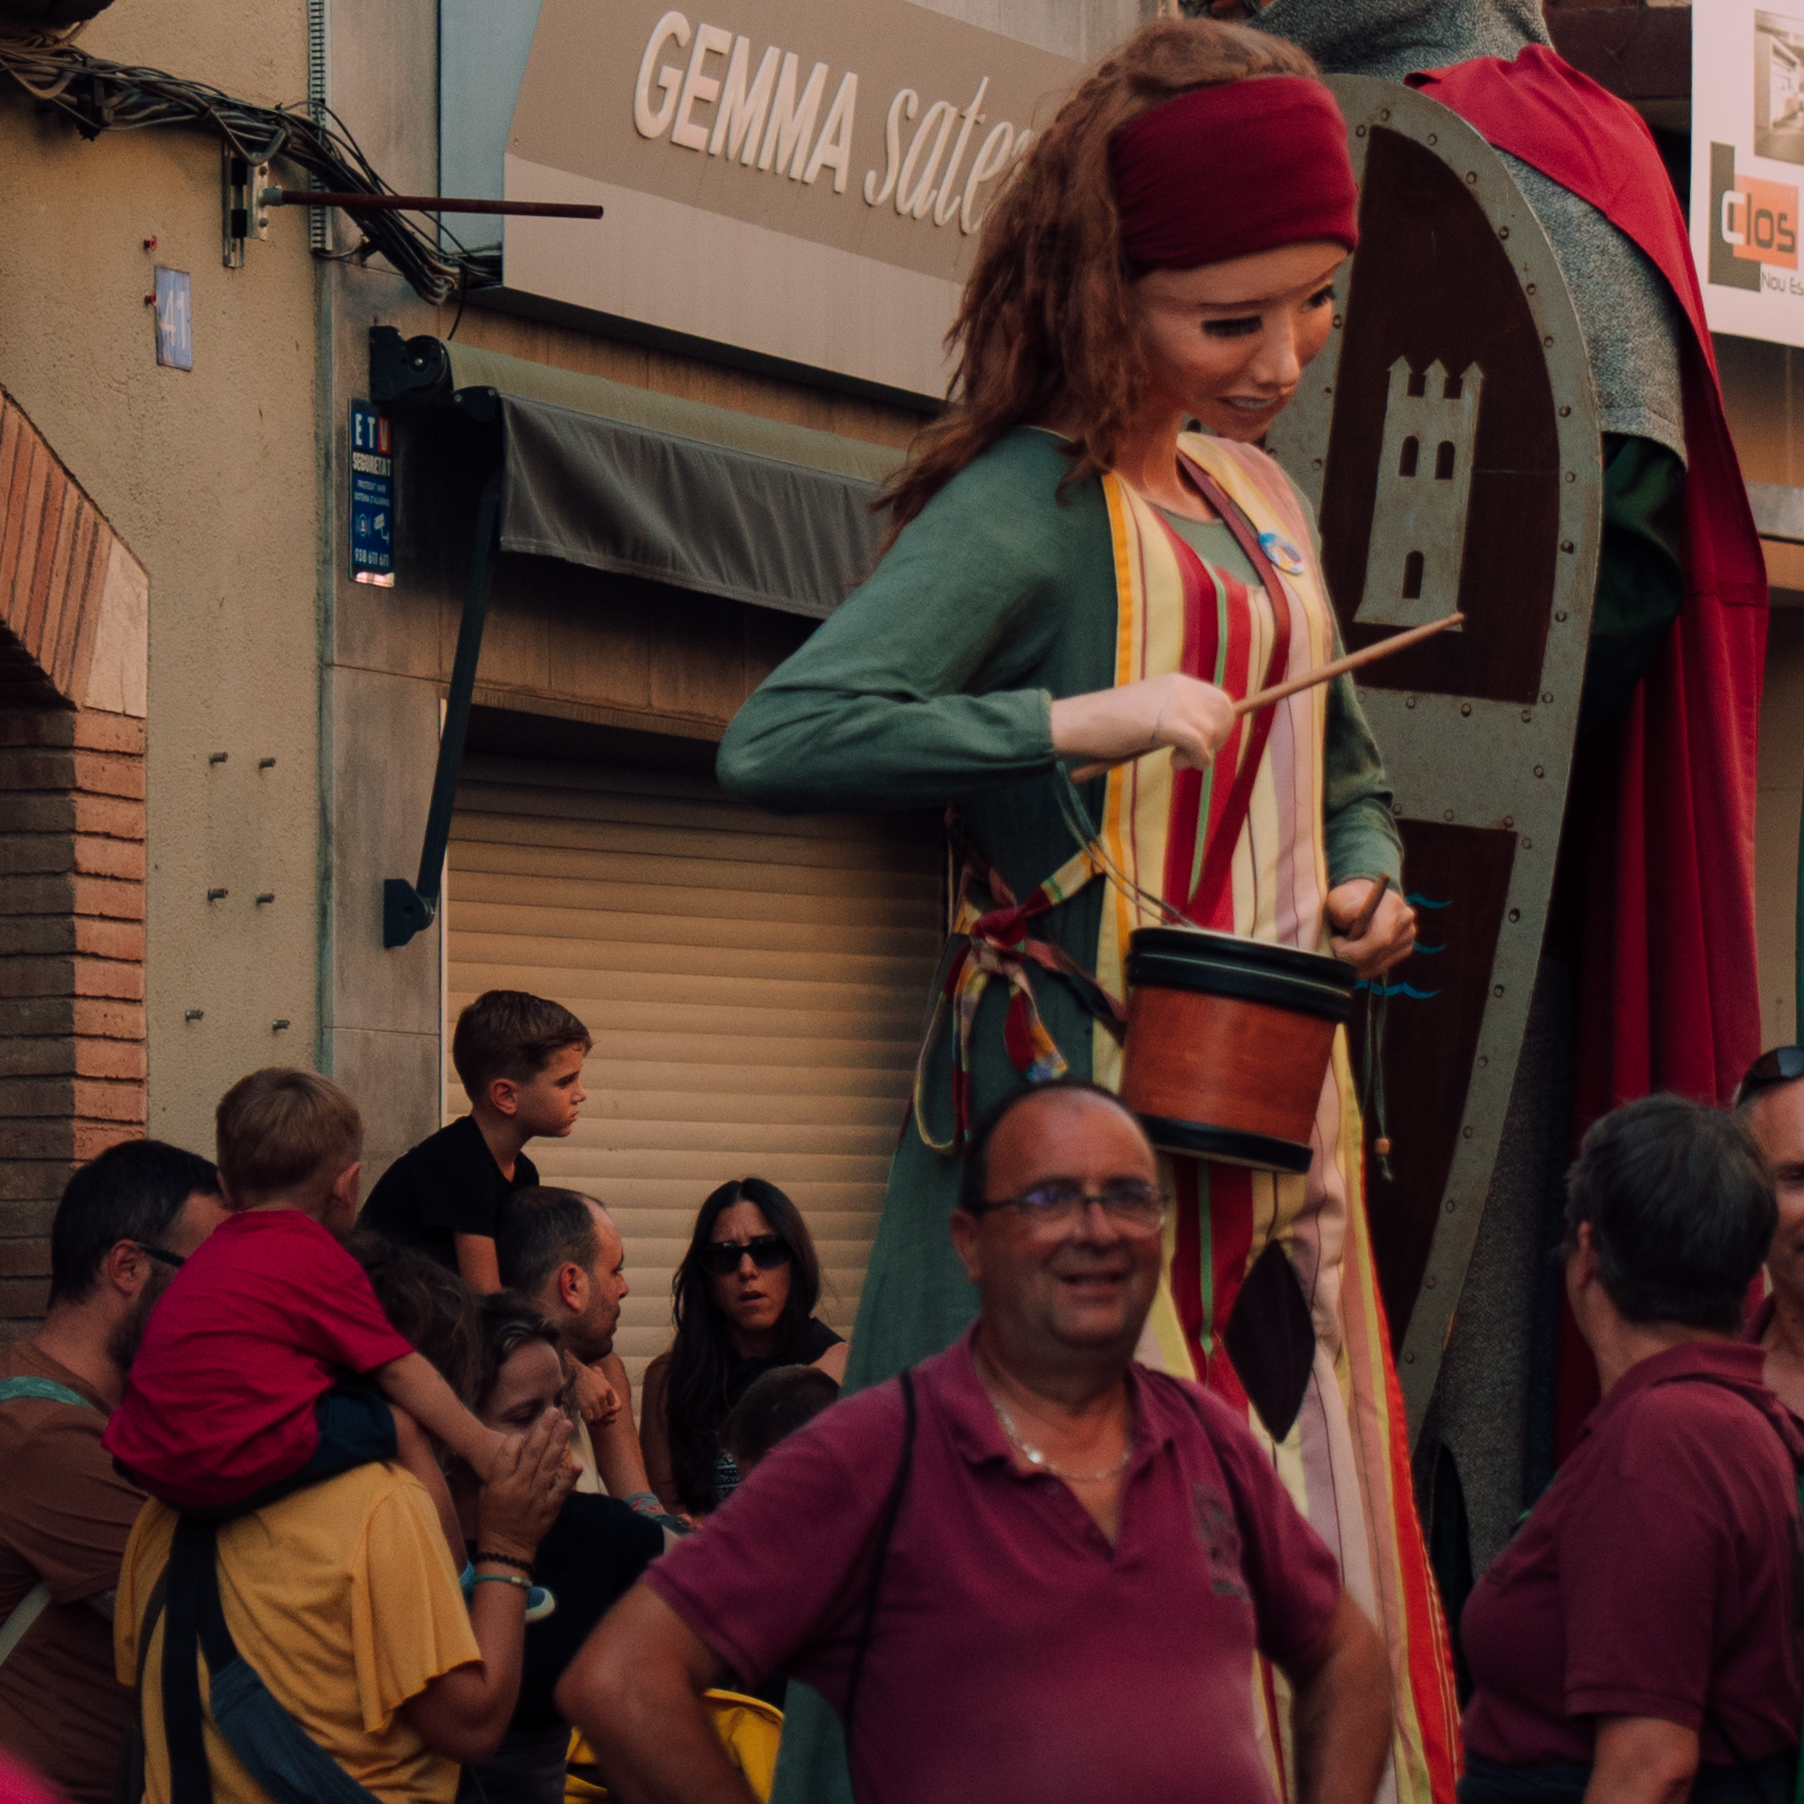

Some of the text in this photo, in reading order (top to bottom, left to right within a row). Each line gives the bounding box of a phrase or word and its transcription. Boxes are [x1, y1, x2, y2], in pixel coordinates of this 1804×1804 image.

[634, 10, 859, 194] GEMMA
[1721, 189, 1796, 253] Clos
[1761, 272, 1786, 292] Nou
[162, 288, 187, 350] 41
